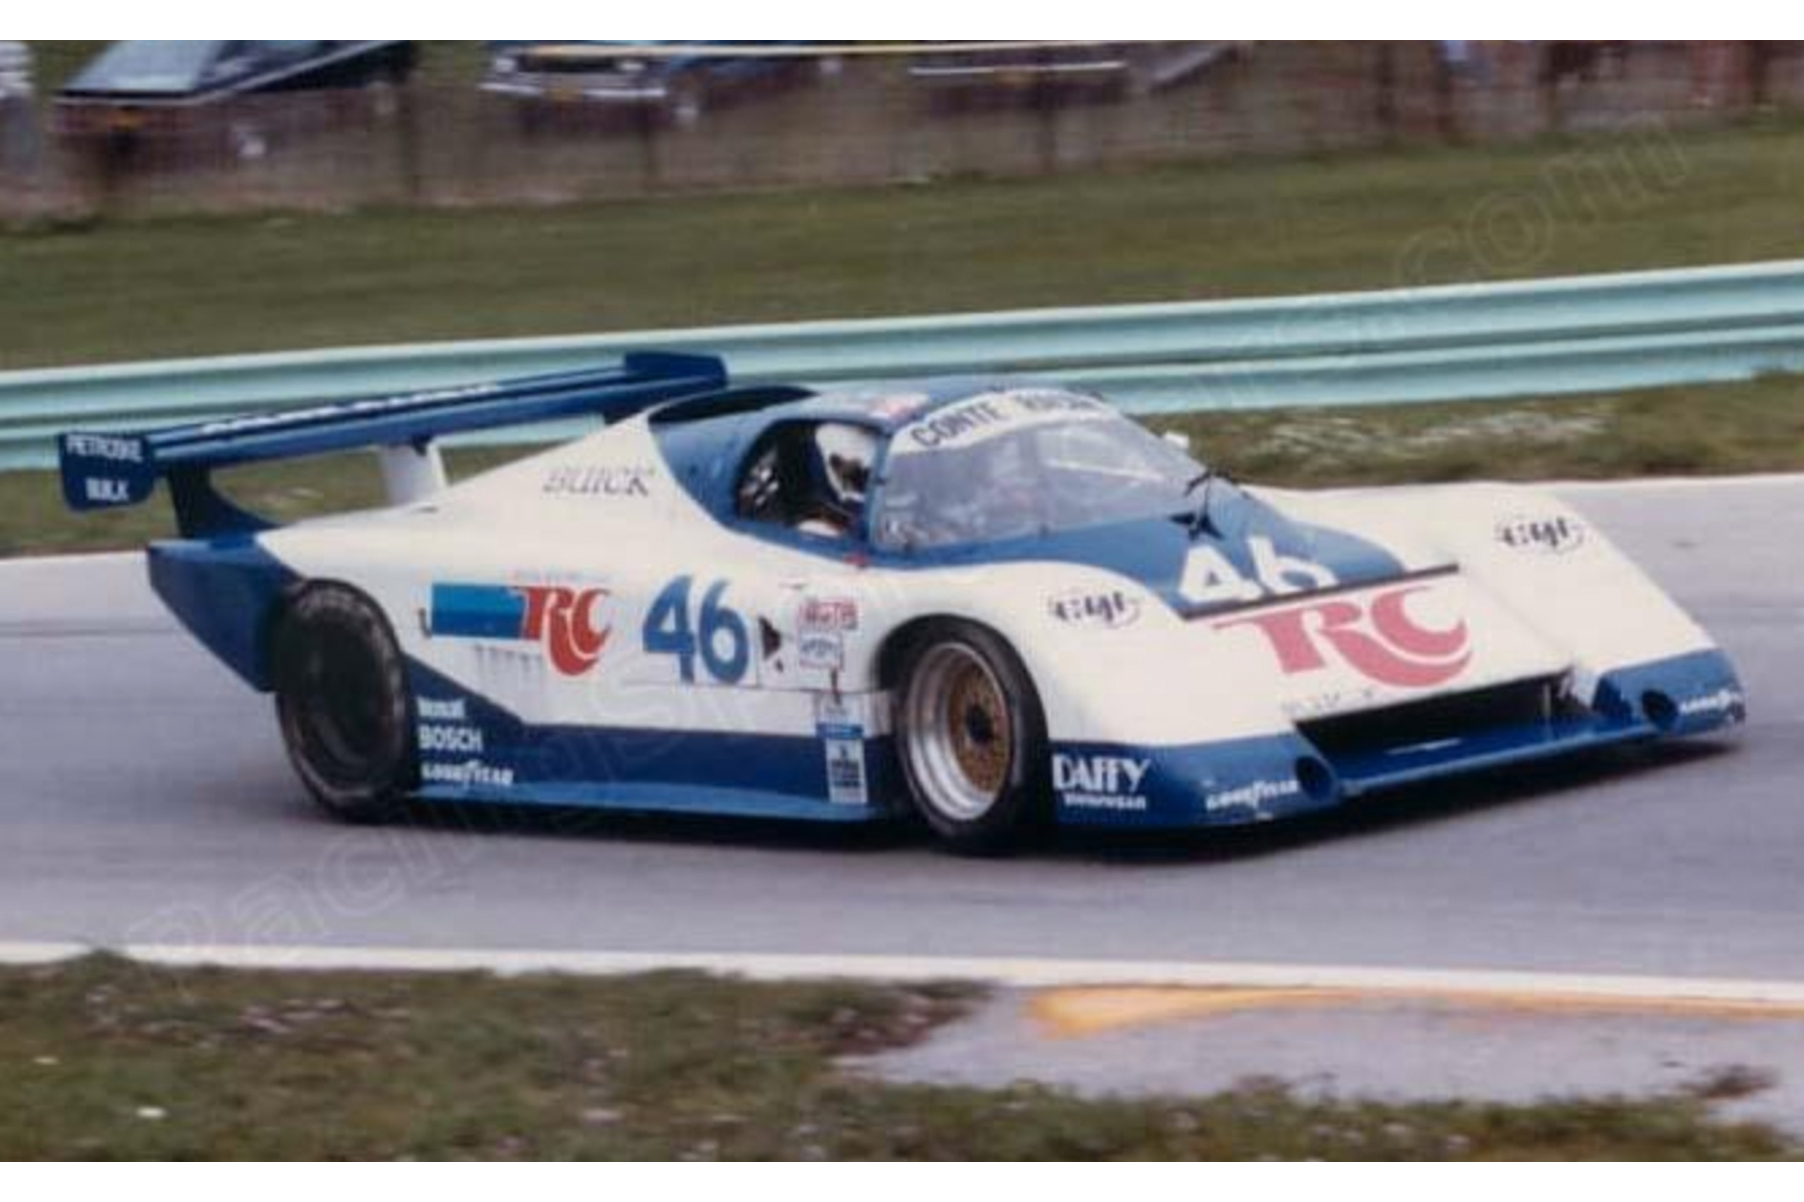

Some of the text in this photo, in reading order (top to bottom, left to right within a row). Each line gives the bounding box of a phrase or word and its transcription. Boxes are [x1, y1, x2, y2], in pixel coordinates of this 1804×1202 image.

[911, 402, 1004, 447] CONTE
[1179, 537, 1340, 602] 46
[512, 586, 611, 676] RC
[642, 574, 749, 685] 46
[1213, 586, 1472, 688] RC
[418, 725, 483, 754] BOSCH
